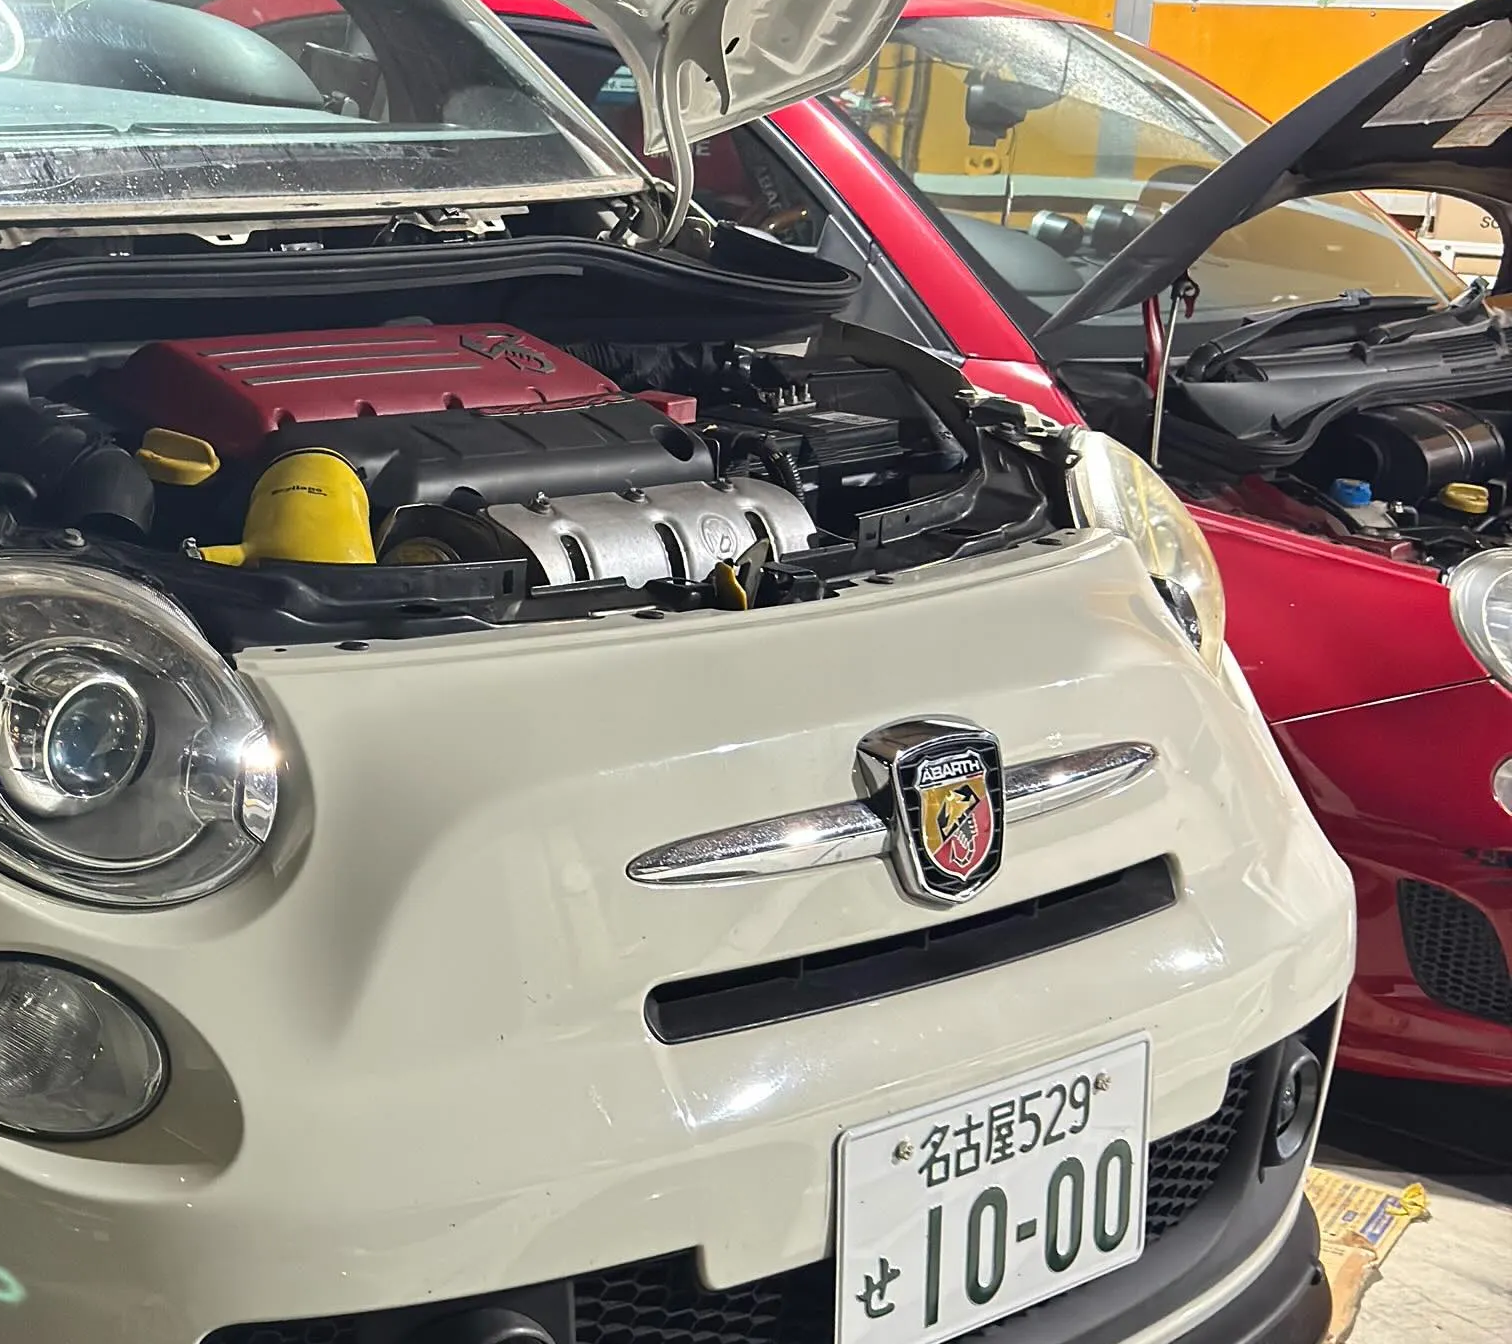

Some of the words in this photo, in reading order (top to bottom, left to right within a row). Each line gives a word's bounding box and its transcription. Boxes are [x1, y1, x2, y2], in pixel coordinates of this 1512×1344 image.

[921, 759, 980, 783] ABARTH
[855, 1256, 901, 1319] せ
[924, 1138, 1133, 1328] 10-00
